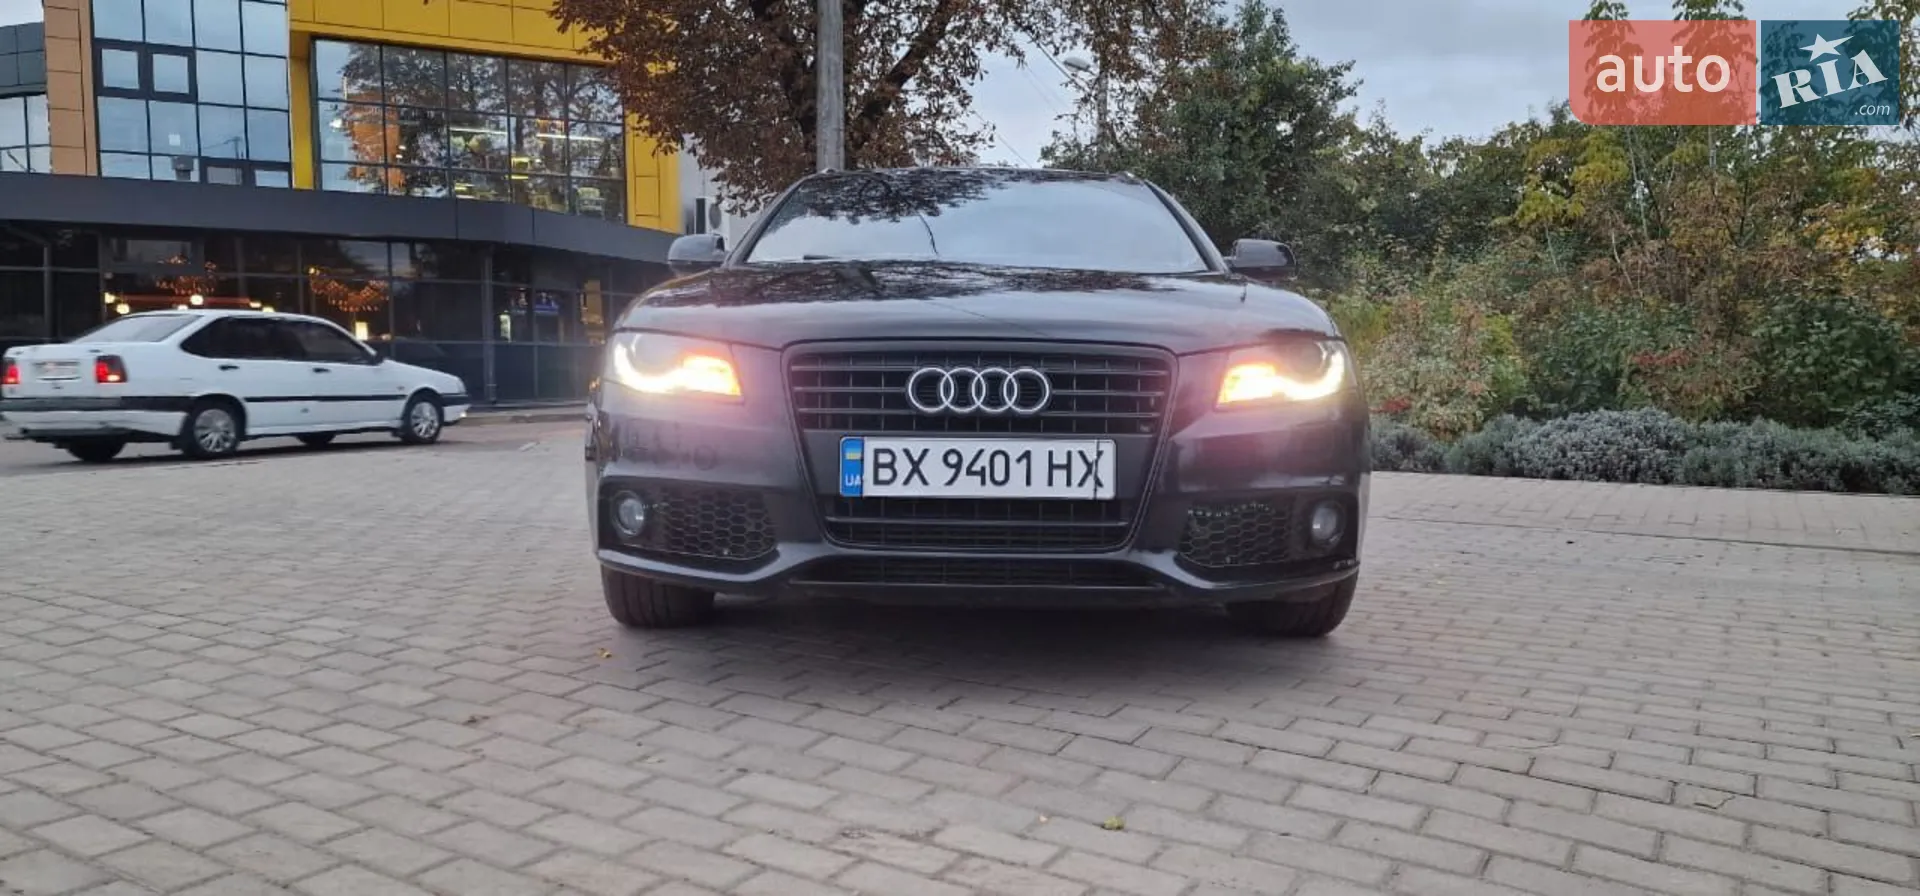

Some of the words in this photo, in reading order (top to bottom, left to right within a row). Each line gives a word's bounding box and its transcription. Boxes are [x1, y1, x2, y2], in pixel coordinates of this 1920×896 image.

[845, 474, 862, 487] UA
[873, 448, 930, 487] BX
[942, 448, 1033, 487] 9401
[1047, 449, 1105, 488] HX
